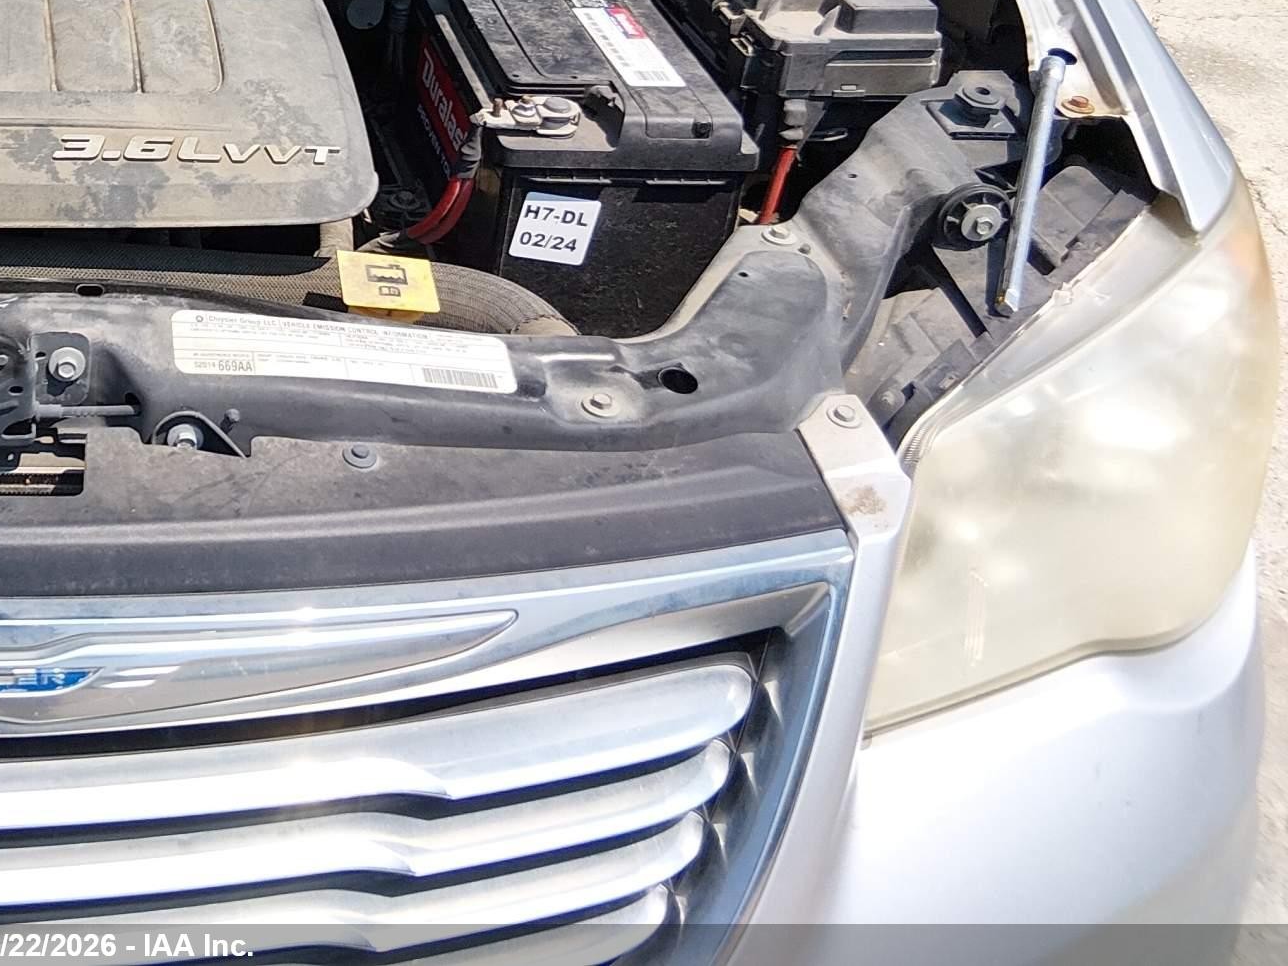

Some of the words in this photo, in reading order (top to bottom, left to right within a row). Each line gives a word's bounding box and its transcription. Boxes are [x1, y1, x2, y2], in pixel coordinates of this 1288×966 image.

[523, 204, 589, 227] H7-DL
[519, 231, 578, 252] 02/24
[282, 320, 310, 330] VEHICLE
[312, 322, 346, 333] EMISSION
[348, 325, 378, 336] CONTROL
